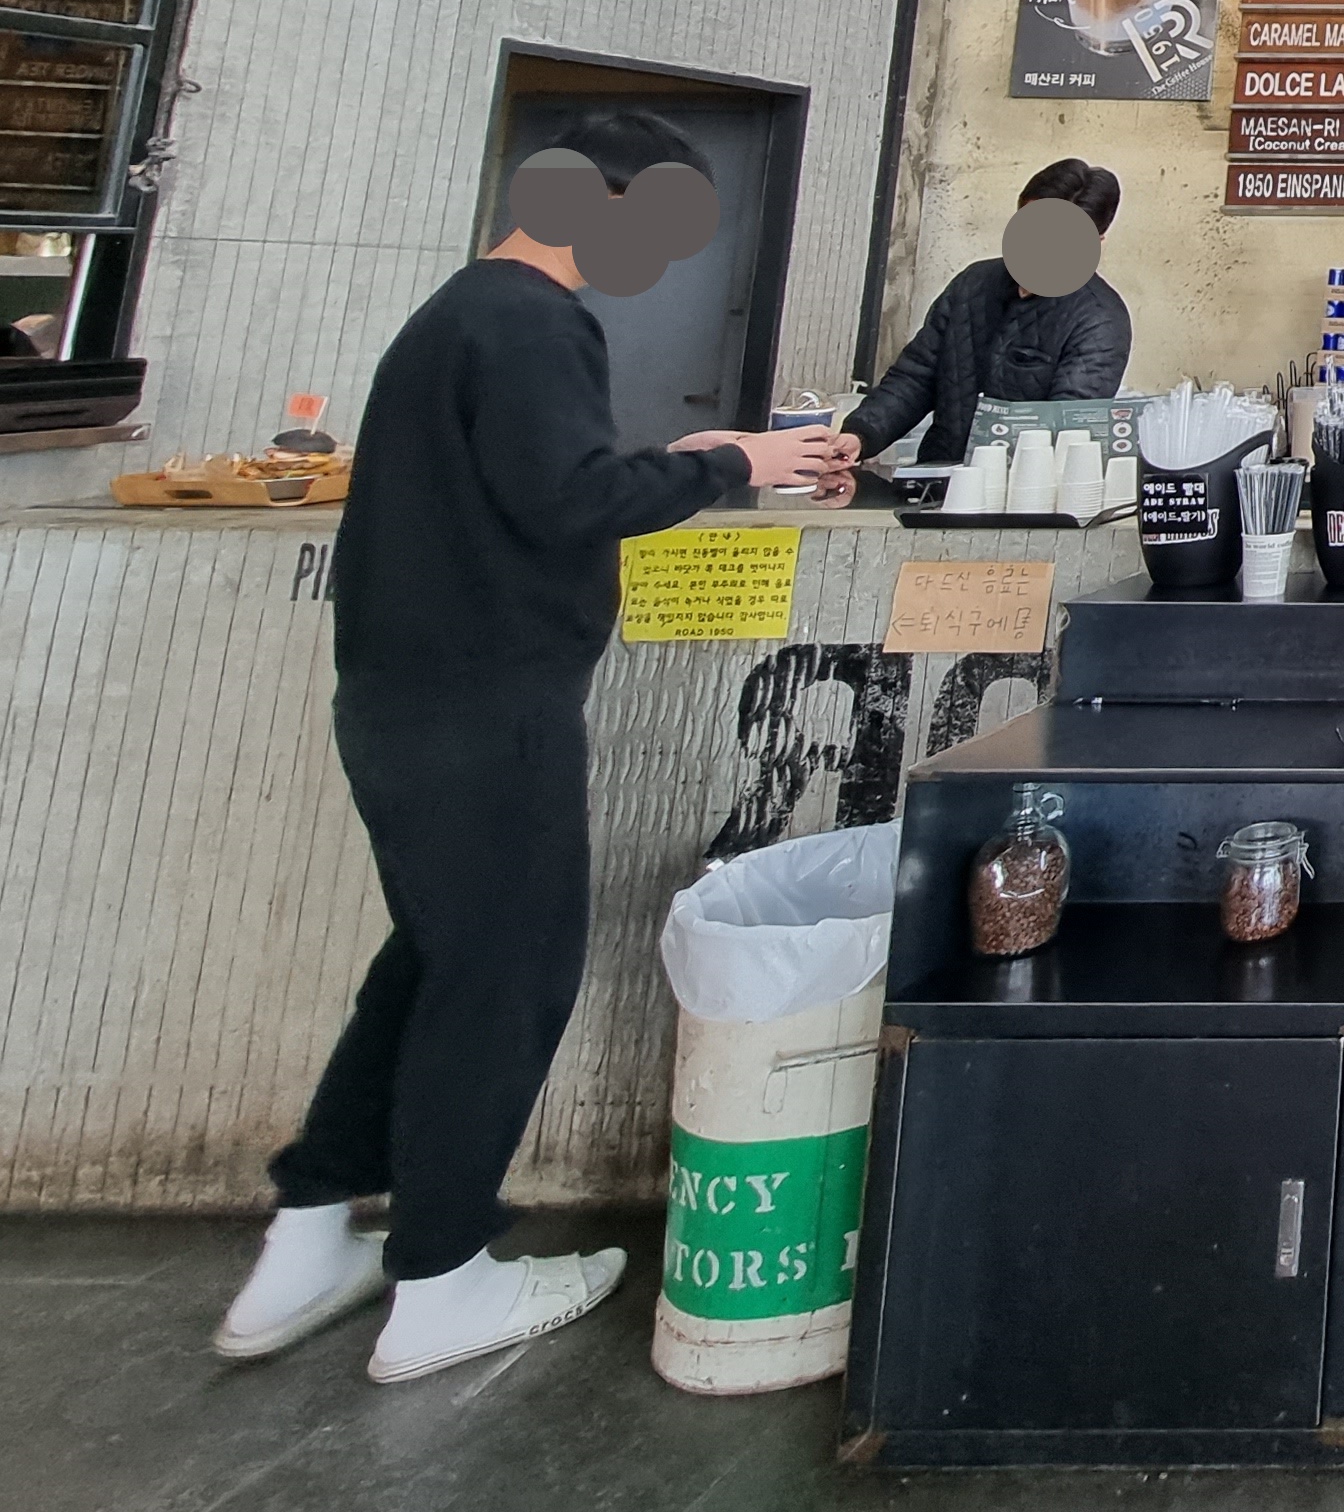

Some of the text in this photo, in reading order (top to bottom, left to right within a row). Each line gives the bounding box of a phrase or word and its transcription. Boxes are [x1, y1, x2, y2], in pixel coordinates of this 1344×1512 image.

[1025, 73, 1095, 87] 매산리 커피
[1245, 73, 1314, 96] DOLCE
[1241, 118, 1340, 136] MAESAN-RI
[1237, 174, 1273, 196] 1950
